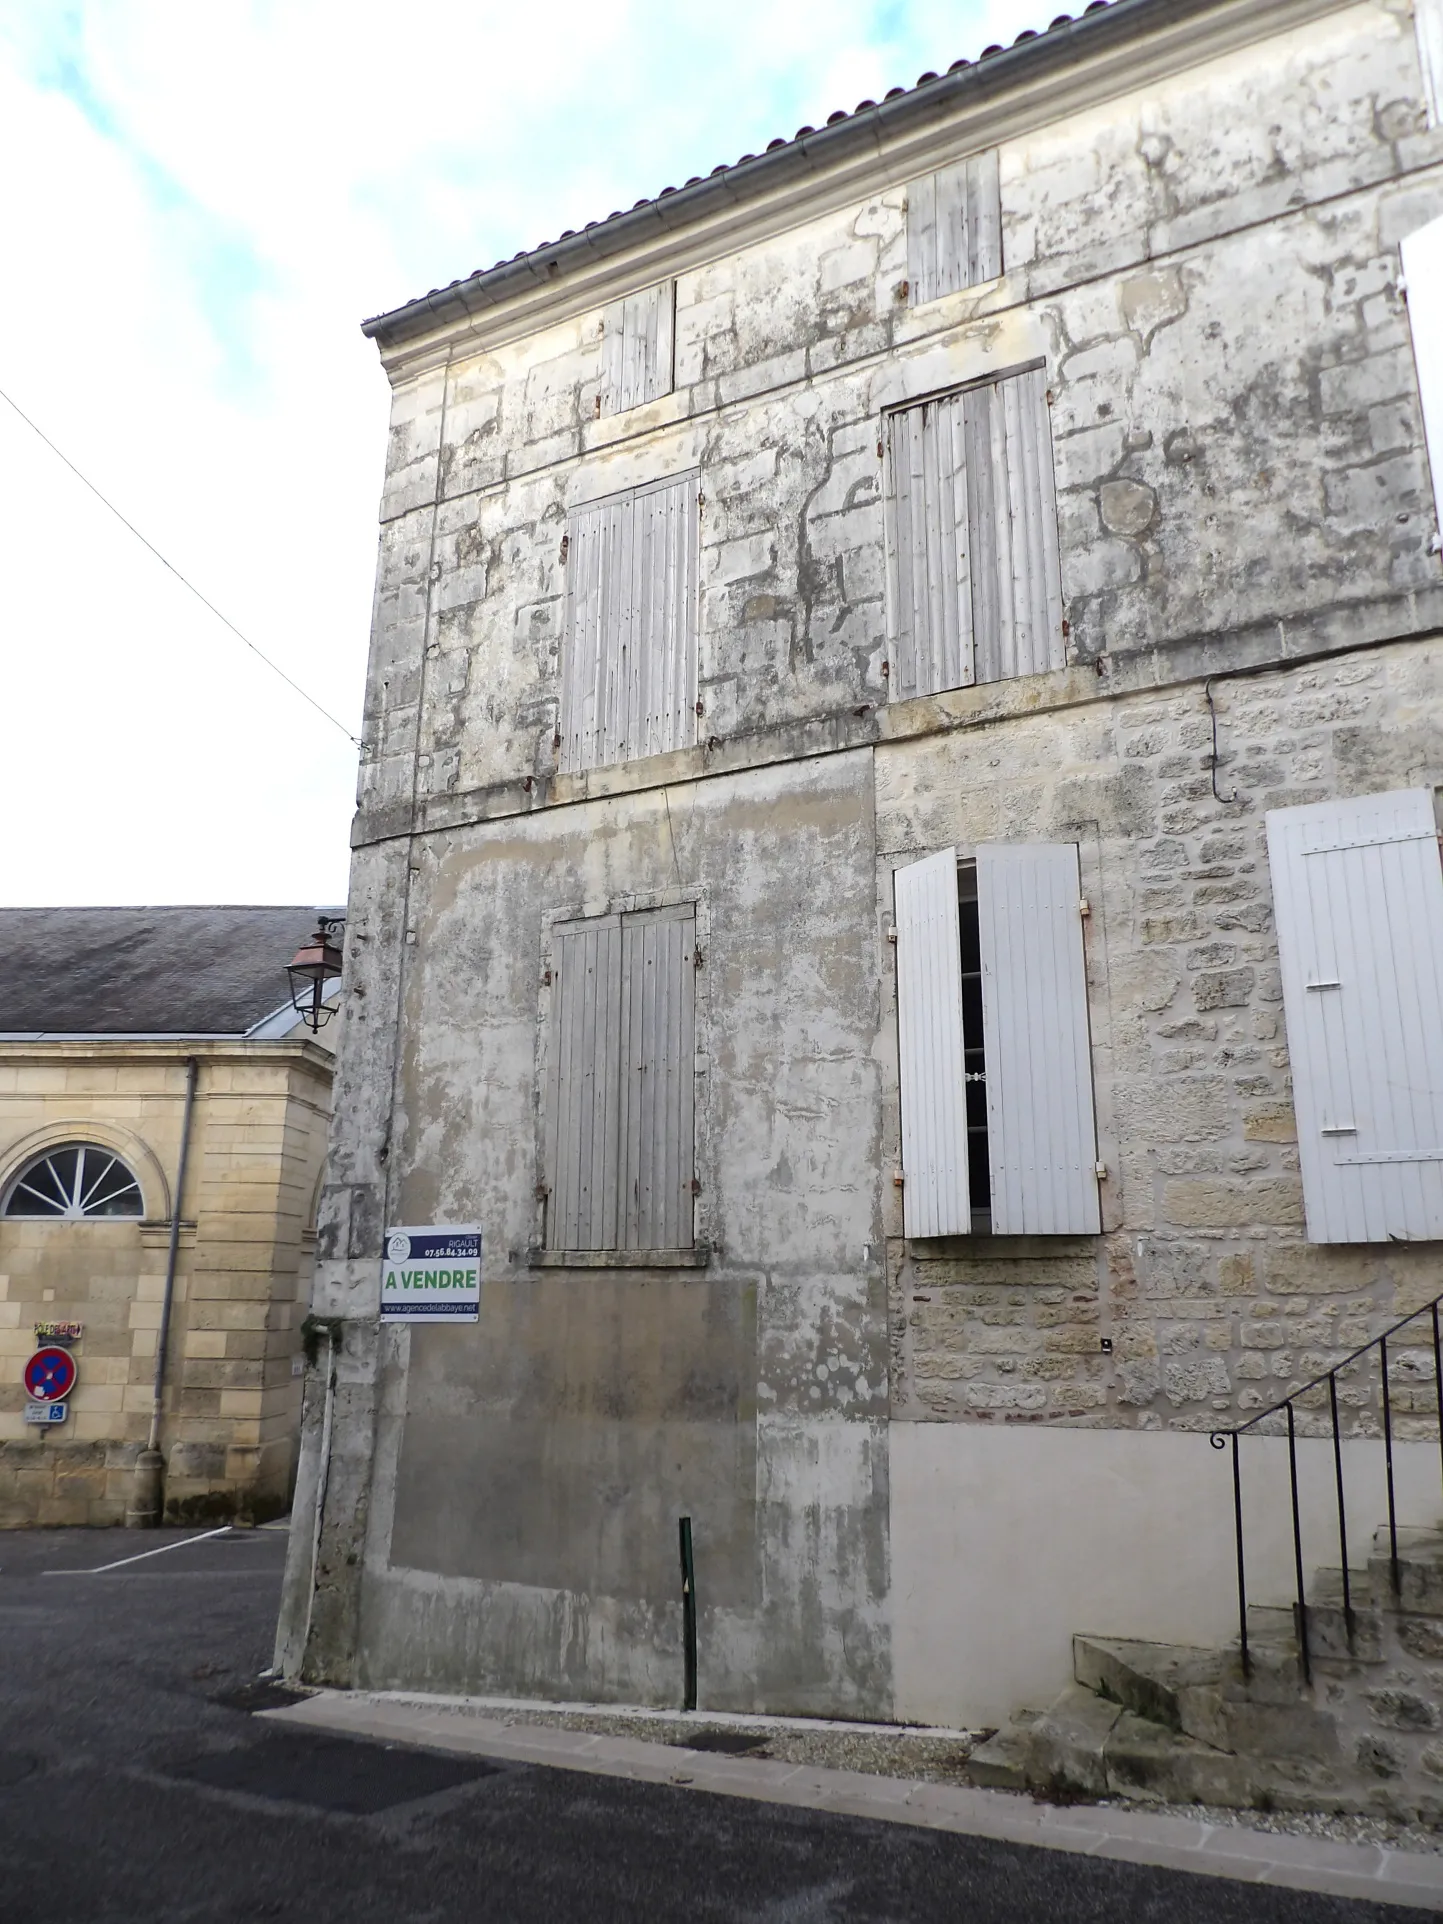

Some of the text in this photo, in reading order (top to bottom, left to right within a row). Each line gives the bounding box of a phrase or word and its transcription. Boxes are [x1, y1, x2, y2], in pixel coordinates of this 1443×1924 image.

[448, 1240, 478, 1248] RIGAULT
[425, 1247, 478, 1257] 07.56.84.34.09
[385, 1270, 477, 1289] A VENDRE
[384, 1304, 476, 1313] www.agencedelabbaye.net
